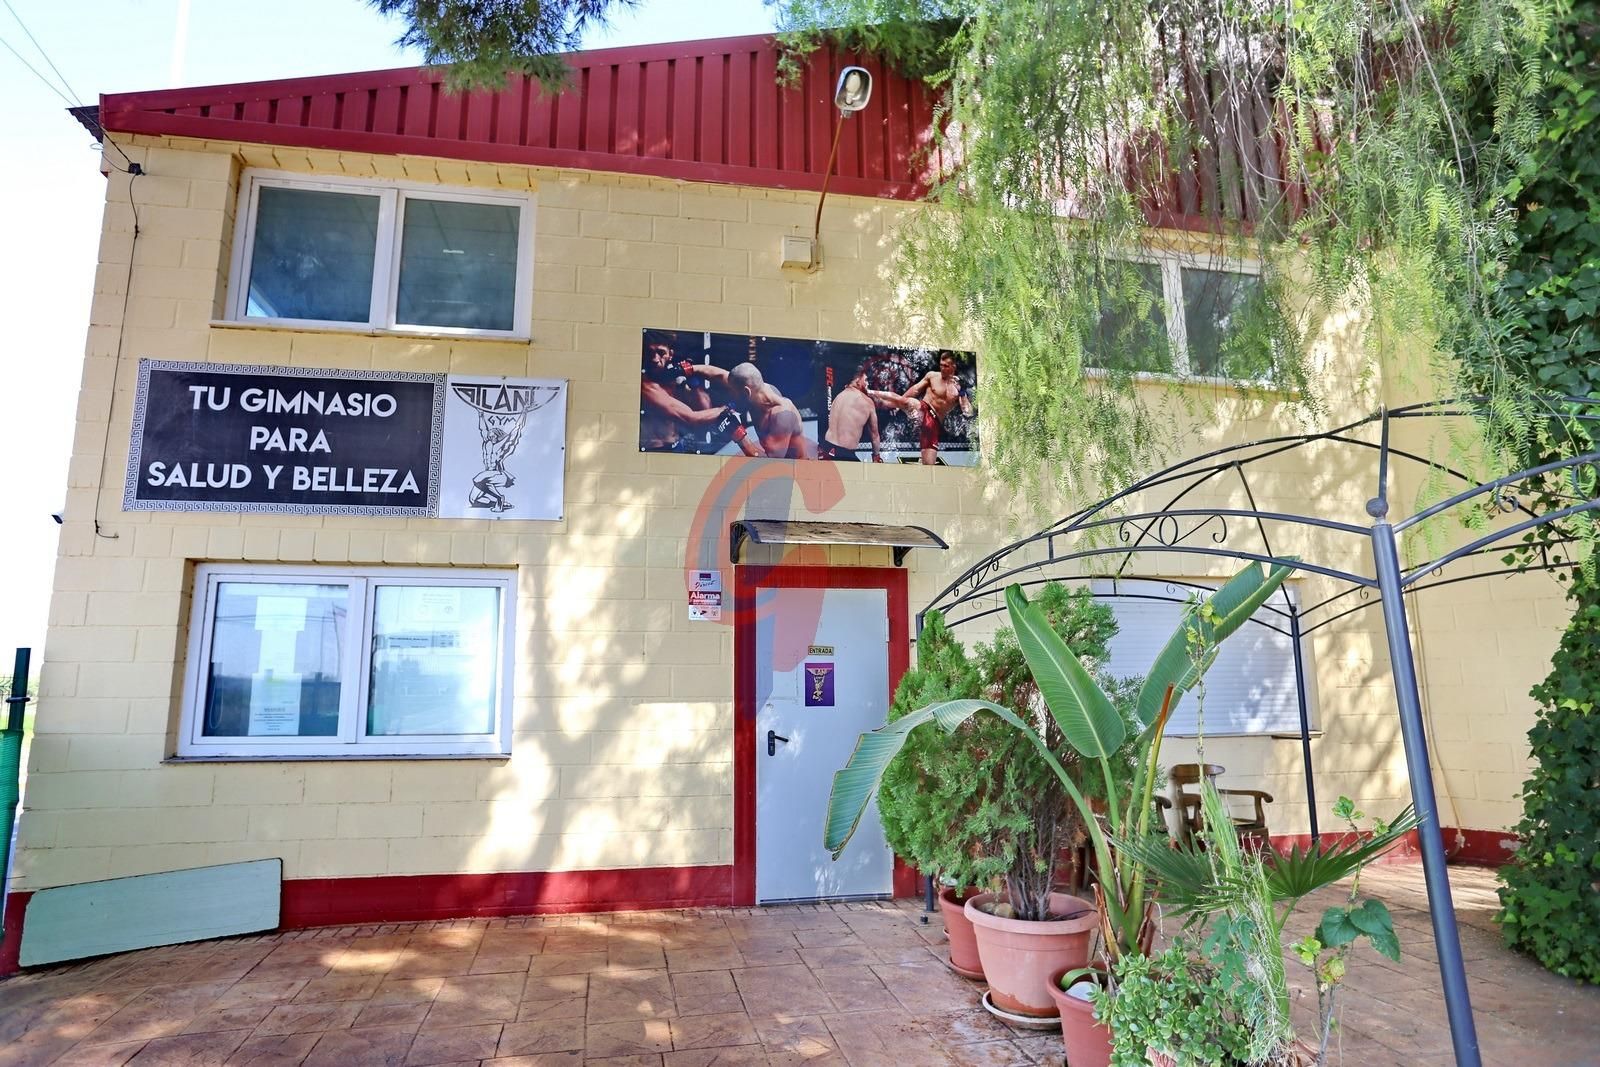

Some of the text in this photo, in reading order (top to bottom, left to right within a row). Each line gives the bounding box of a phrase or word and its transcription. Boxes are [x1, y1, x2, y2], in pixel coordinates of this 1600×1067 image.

[189, 385, 397, 418] TU GIMNASIO
[487, 415, 517, 426] GYM
[718, 416, 731, 432] UFC
[249, 426, 332, 453] PARA
[147, 461, 421, 495] SALUD Y BELLEZA
[691, 591, 721, 600] Alarma
